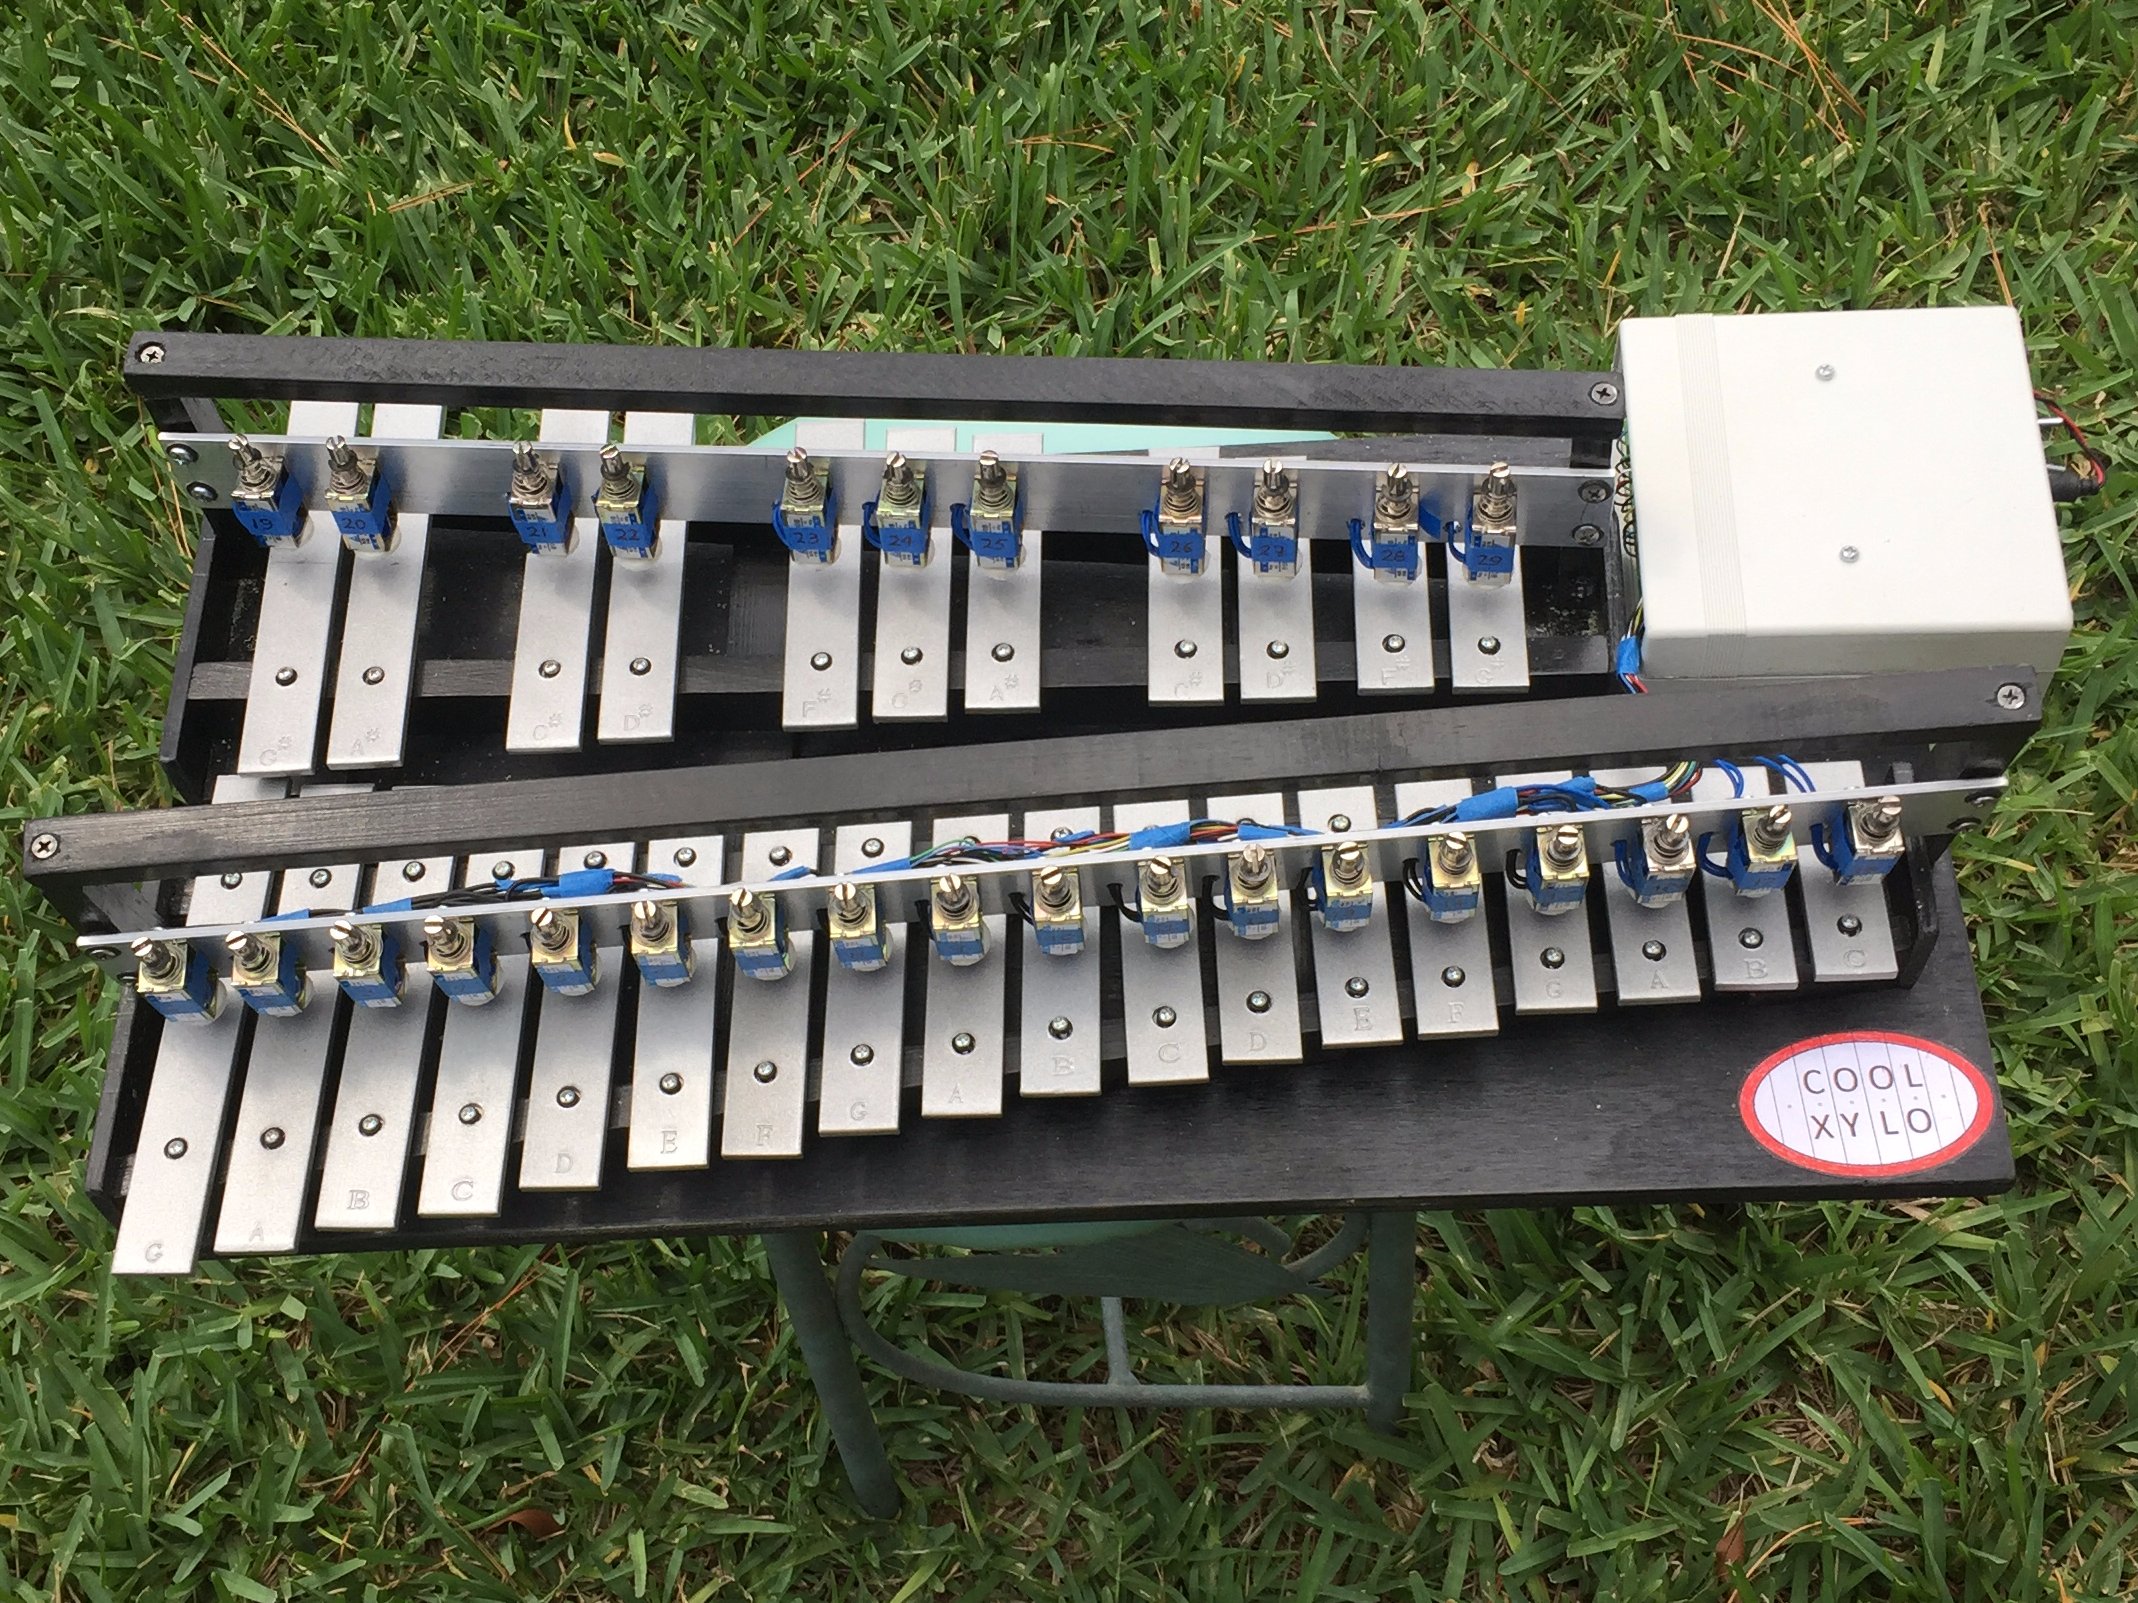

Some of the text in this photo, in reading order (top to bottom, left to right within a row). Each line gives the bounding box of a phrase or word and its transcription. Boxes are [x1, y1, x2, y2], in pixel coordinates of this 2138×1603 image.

[251, 517, 274, 530] 19
[341, 517, 366, 530] 20
[526, 526, 548, 538] 21
[615, 528, 641, 541] 22
[792, 531, 819, 545] 23
[1169, 540, 1194, 553] 26
[1476, 554, 1504, 567] 29
[1743, 957, 1769, 979] B
[1649, 968, 1669, 990] A
[1353, 1006, 1373, 1031] E
[1447, 1001, 1465, 1024] F
[1249, 1031, 1268, 1052] D
[1157, 1042, 1181, 1063] C
[1051, 1055, 1075, 1076] B
[1803, 1063, 1923, 1094] COOL
[948, 1083, 964, 1104] A
[849, 1101, 868, 1122] G
[1811, 1107, 1932, 1139] XYLO
[660, 1130, 679, 1154] E
[756, 1124, 774, 1147] F
[555, 1153, 574, 1174] D
[346, 1189, 370, 1210] B
[451, 1180, 474, 1201] C
[248, 1221, 265, 1243] A
[144, 1242, 164, 1263] G
